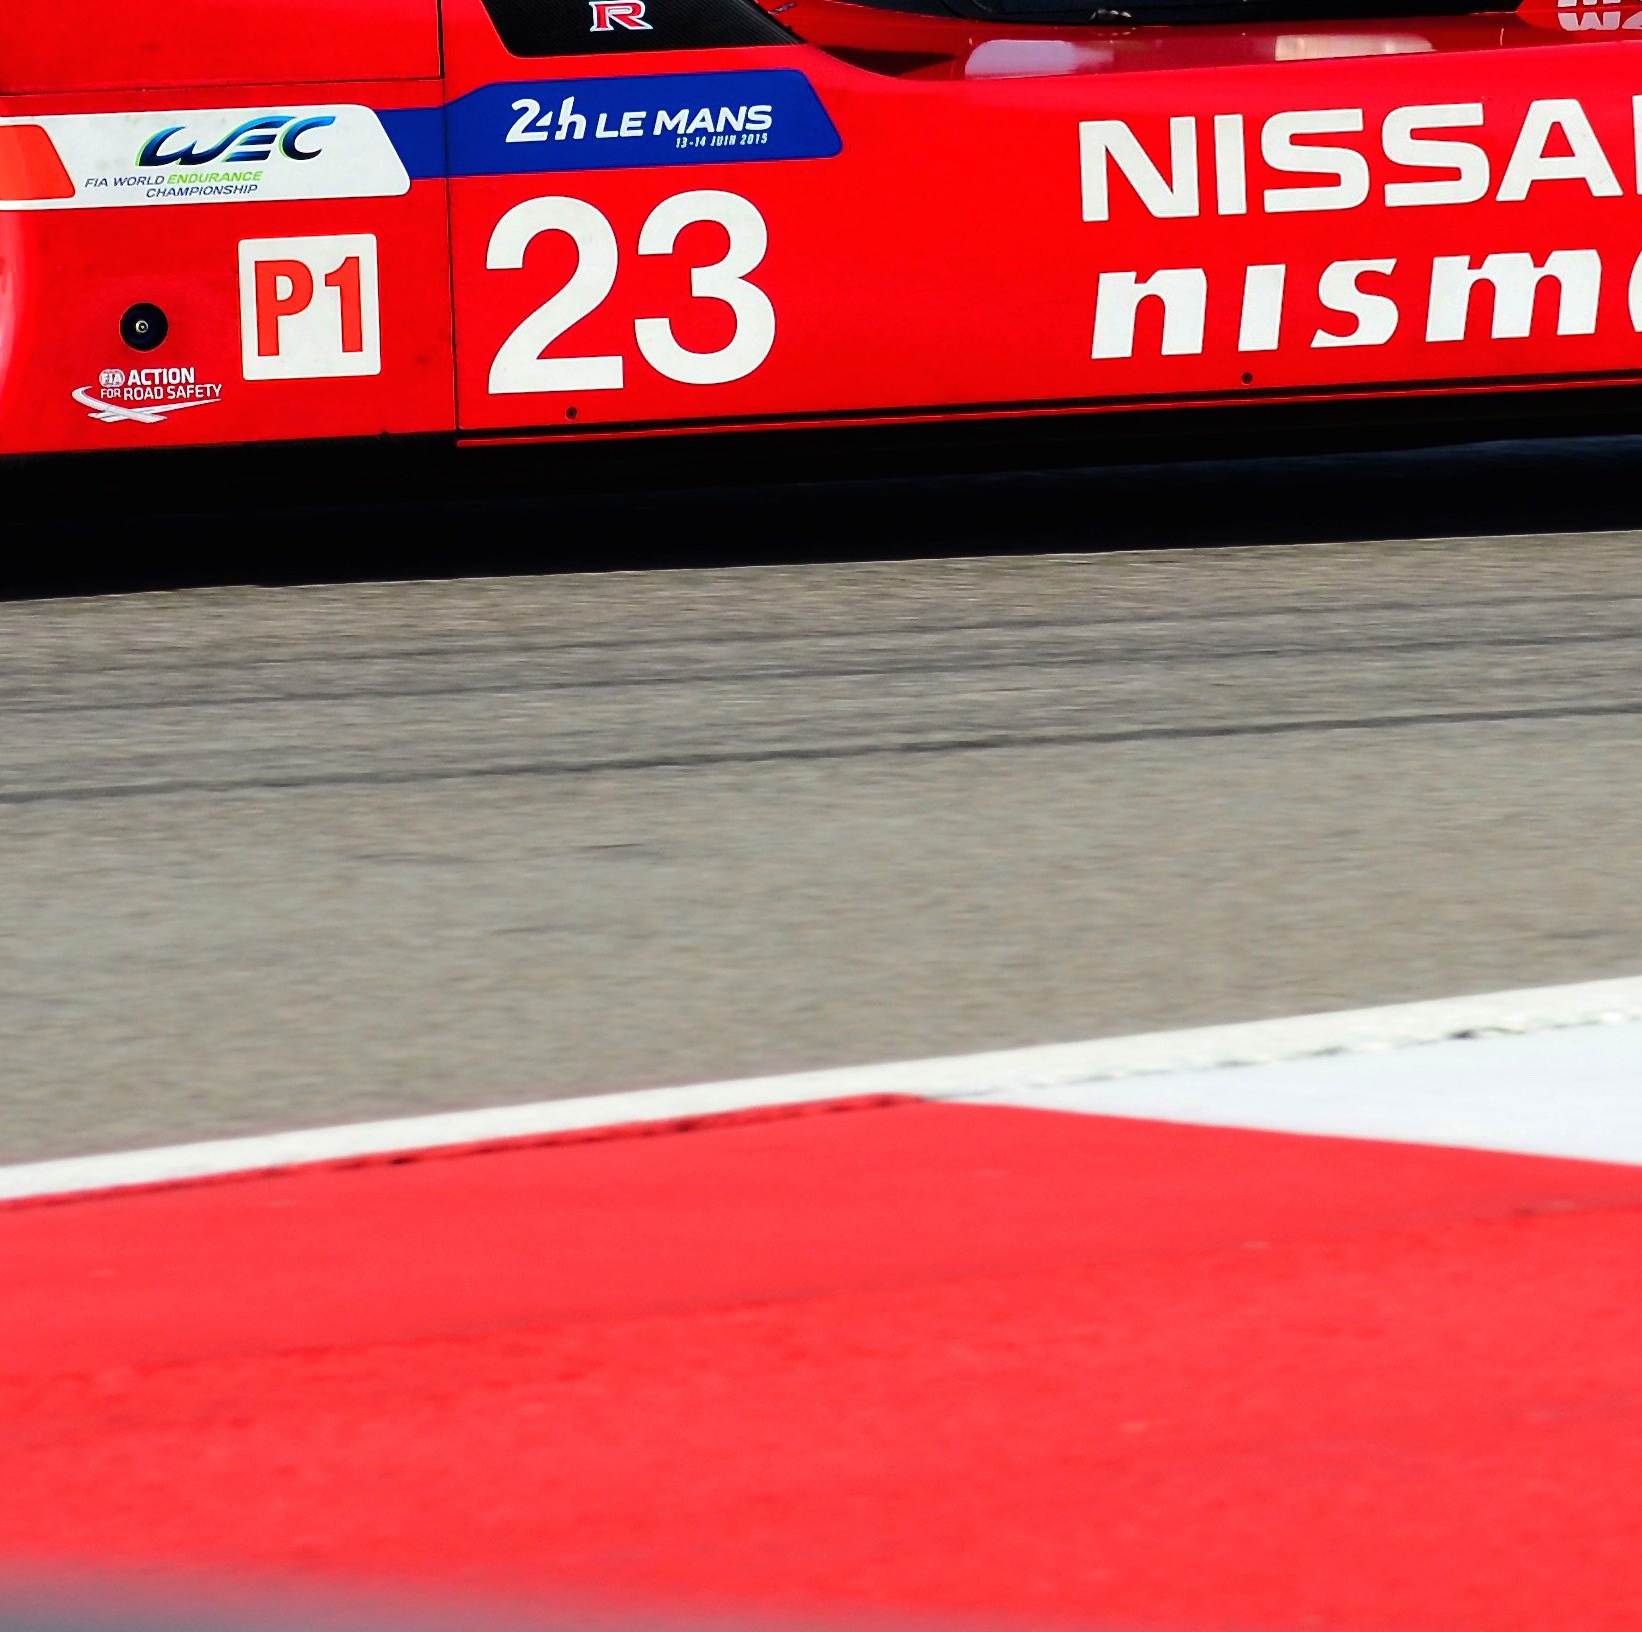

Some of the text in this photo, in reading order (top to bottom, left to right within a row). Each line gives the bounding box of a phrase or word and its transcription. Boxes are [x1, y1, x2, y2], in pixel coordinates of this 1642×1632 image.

[588, 0, 654, 33] R
[595, 111, 647, 139] LE
[653, 104, 773, 136] MANS
[134, 115, 337, 167] WEC
[675, 136, 707, 149] 13-14
[740, 132, 769, 146] 2015
[84, 170, 263, 189] FIA WORLD ENDURANCE
[145, 183, 258, 199] CHAMPIONSHIP
[486, 189, 776, 394] 23
[254, 255, 364, 357] P1
[127, 367, 195, 386] ACTION
[100, 383, 223, 401] FOR ROAD SAFETY
